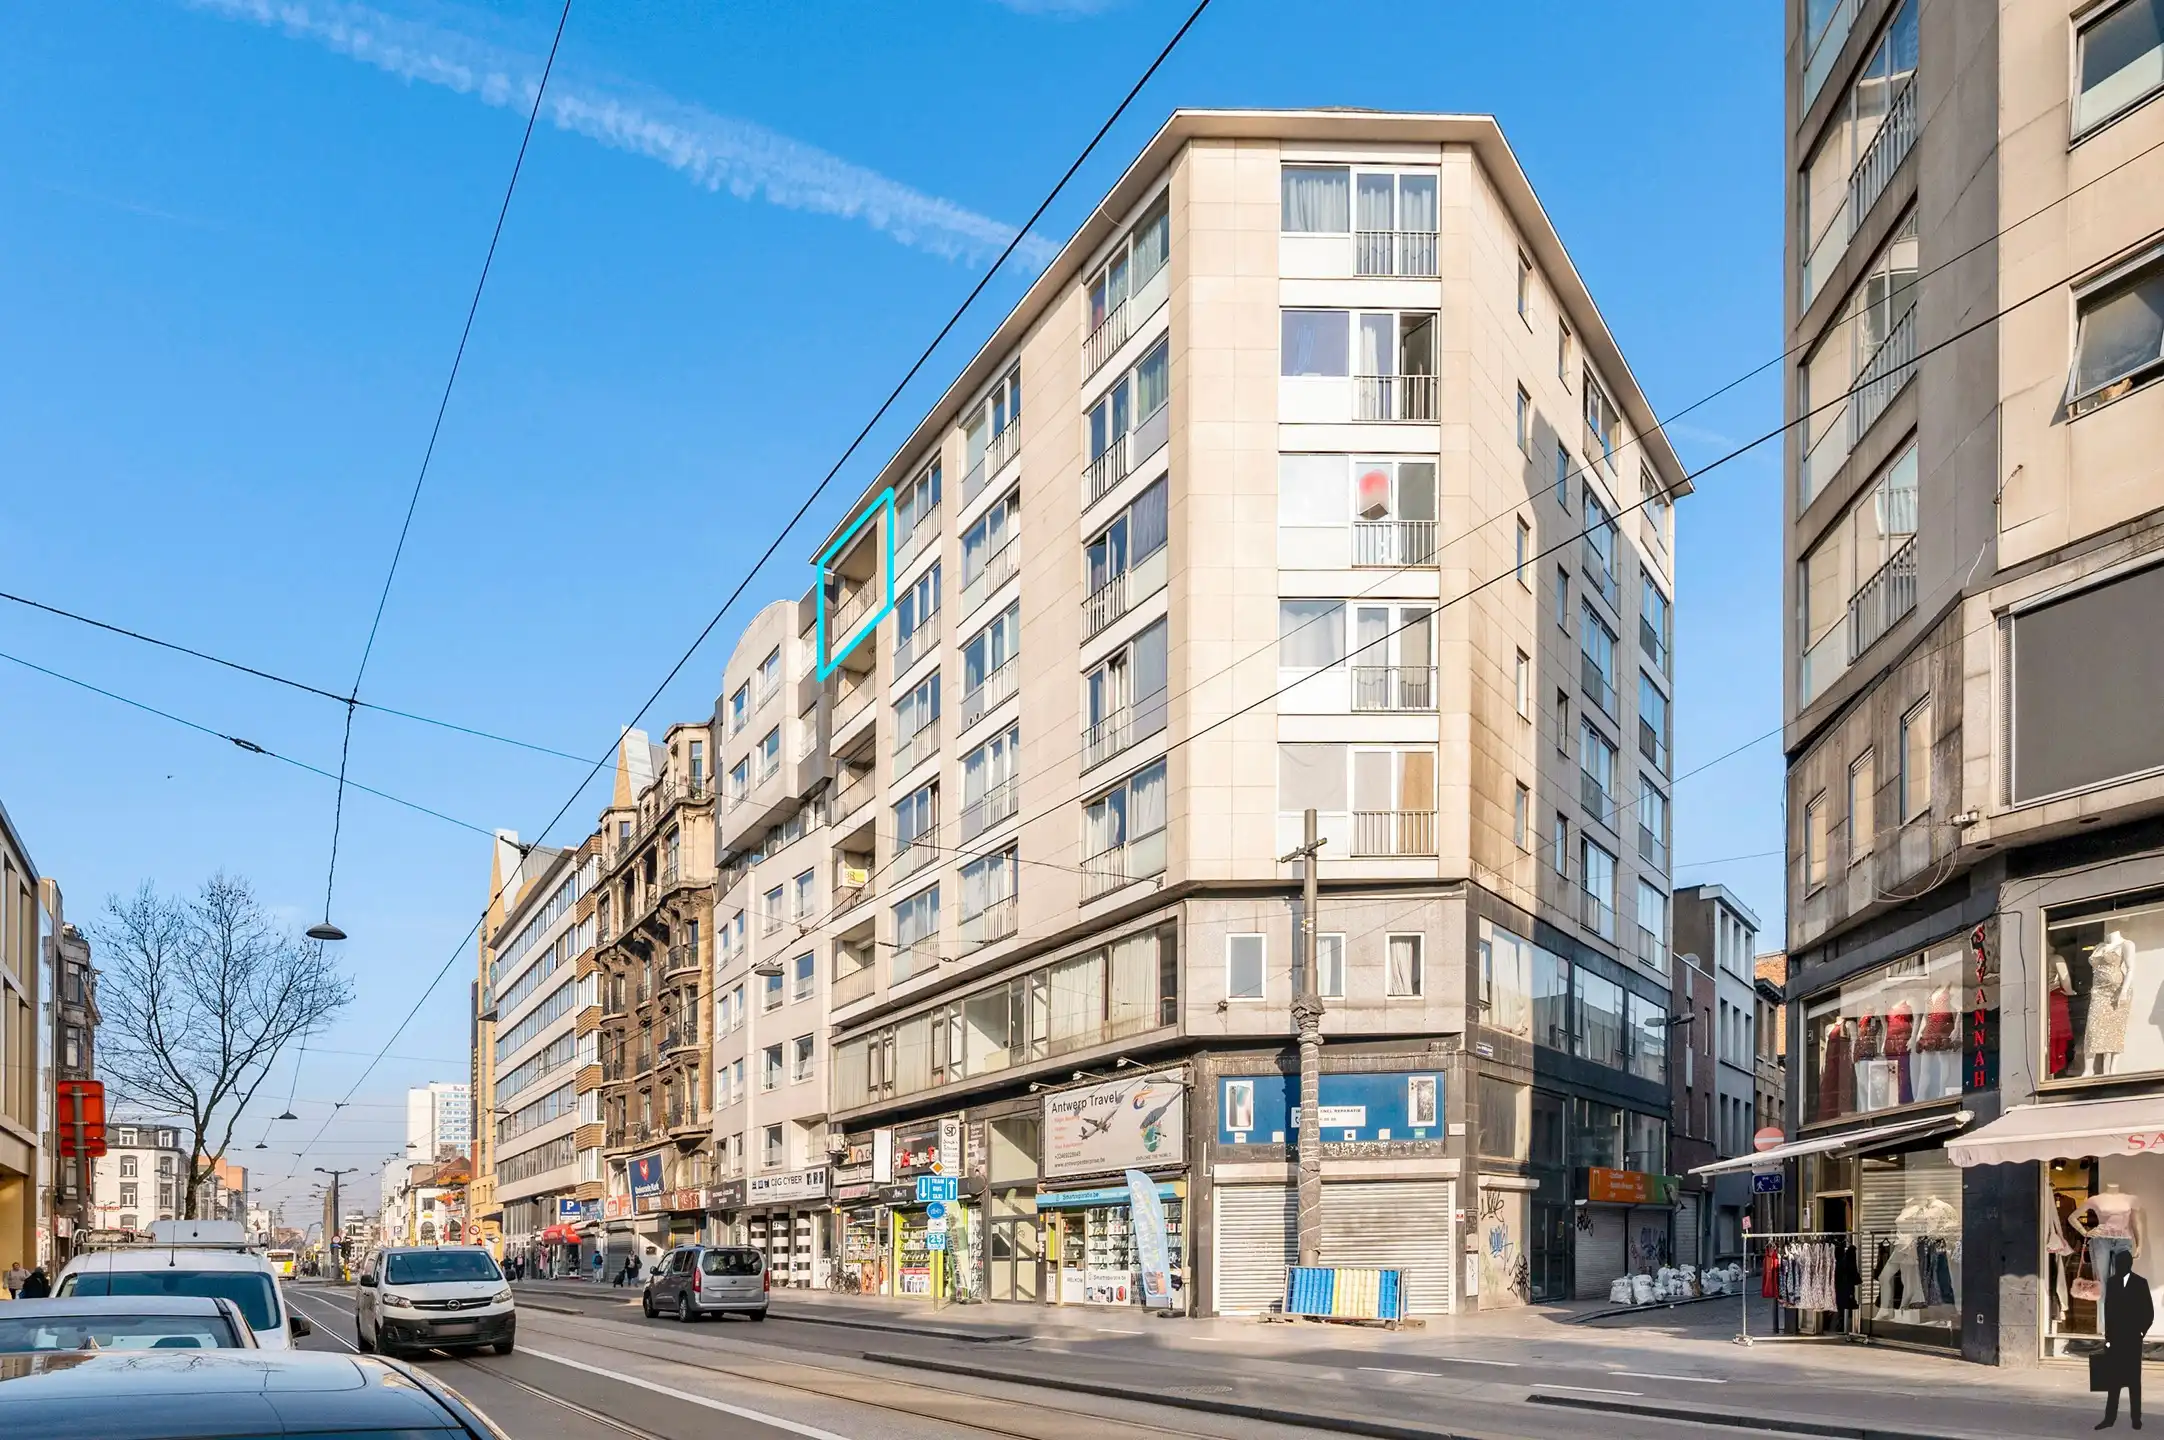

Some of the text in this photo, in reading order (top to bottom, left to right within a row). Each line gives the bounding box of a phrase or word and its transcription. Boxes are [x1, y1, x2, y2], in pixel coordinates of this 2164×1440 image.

[1972, 925, 1987, 1088] SAVANNAH
[1051, 1090, 1118, 1114] Antwerp Travel
[2127, 1131, 2164, 1150] SA
[783, 1175, 803, 1186] CYBER
[566, 1199, 575, 1210] P
